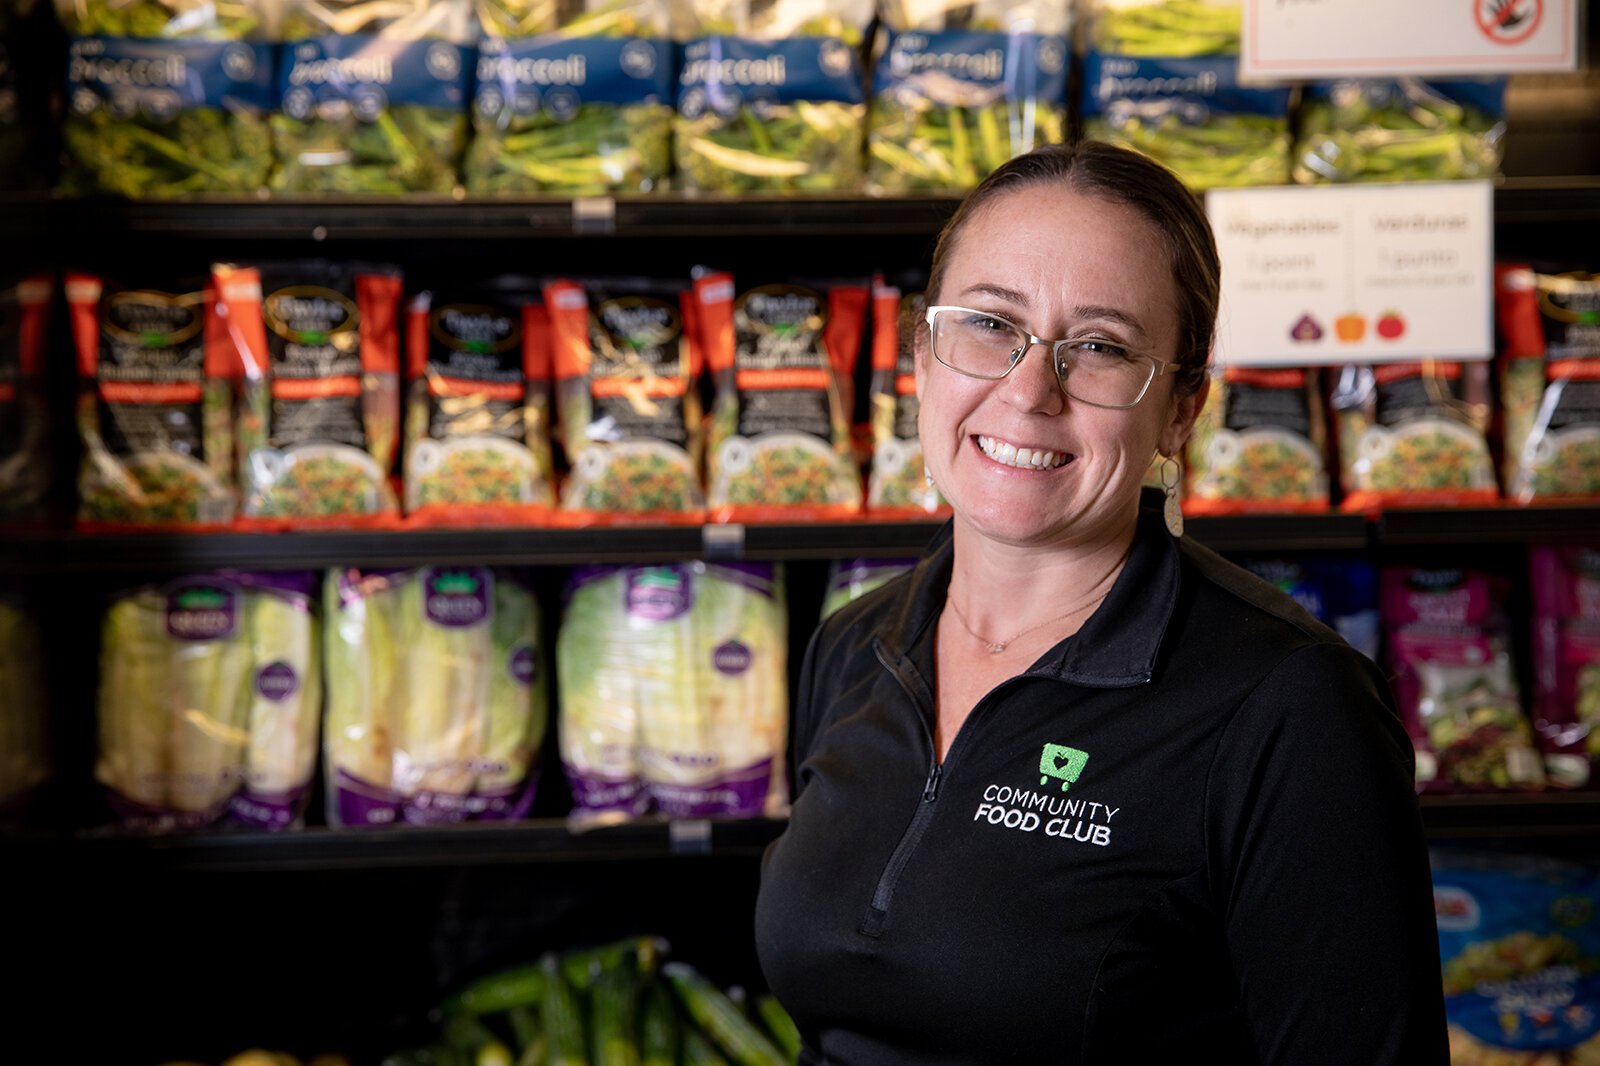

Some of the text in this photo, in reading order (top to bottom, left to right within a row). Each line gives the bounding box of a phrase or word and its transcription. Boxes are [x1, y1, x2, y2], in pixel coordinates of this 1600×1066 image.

[983, 784, 1120, 823] COMMUNITY
[974, 803, 1111, 846] FOOD CLUB
